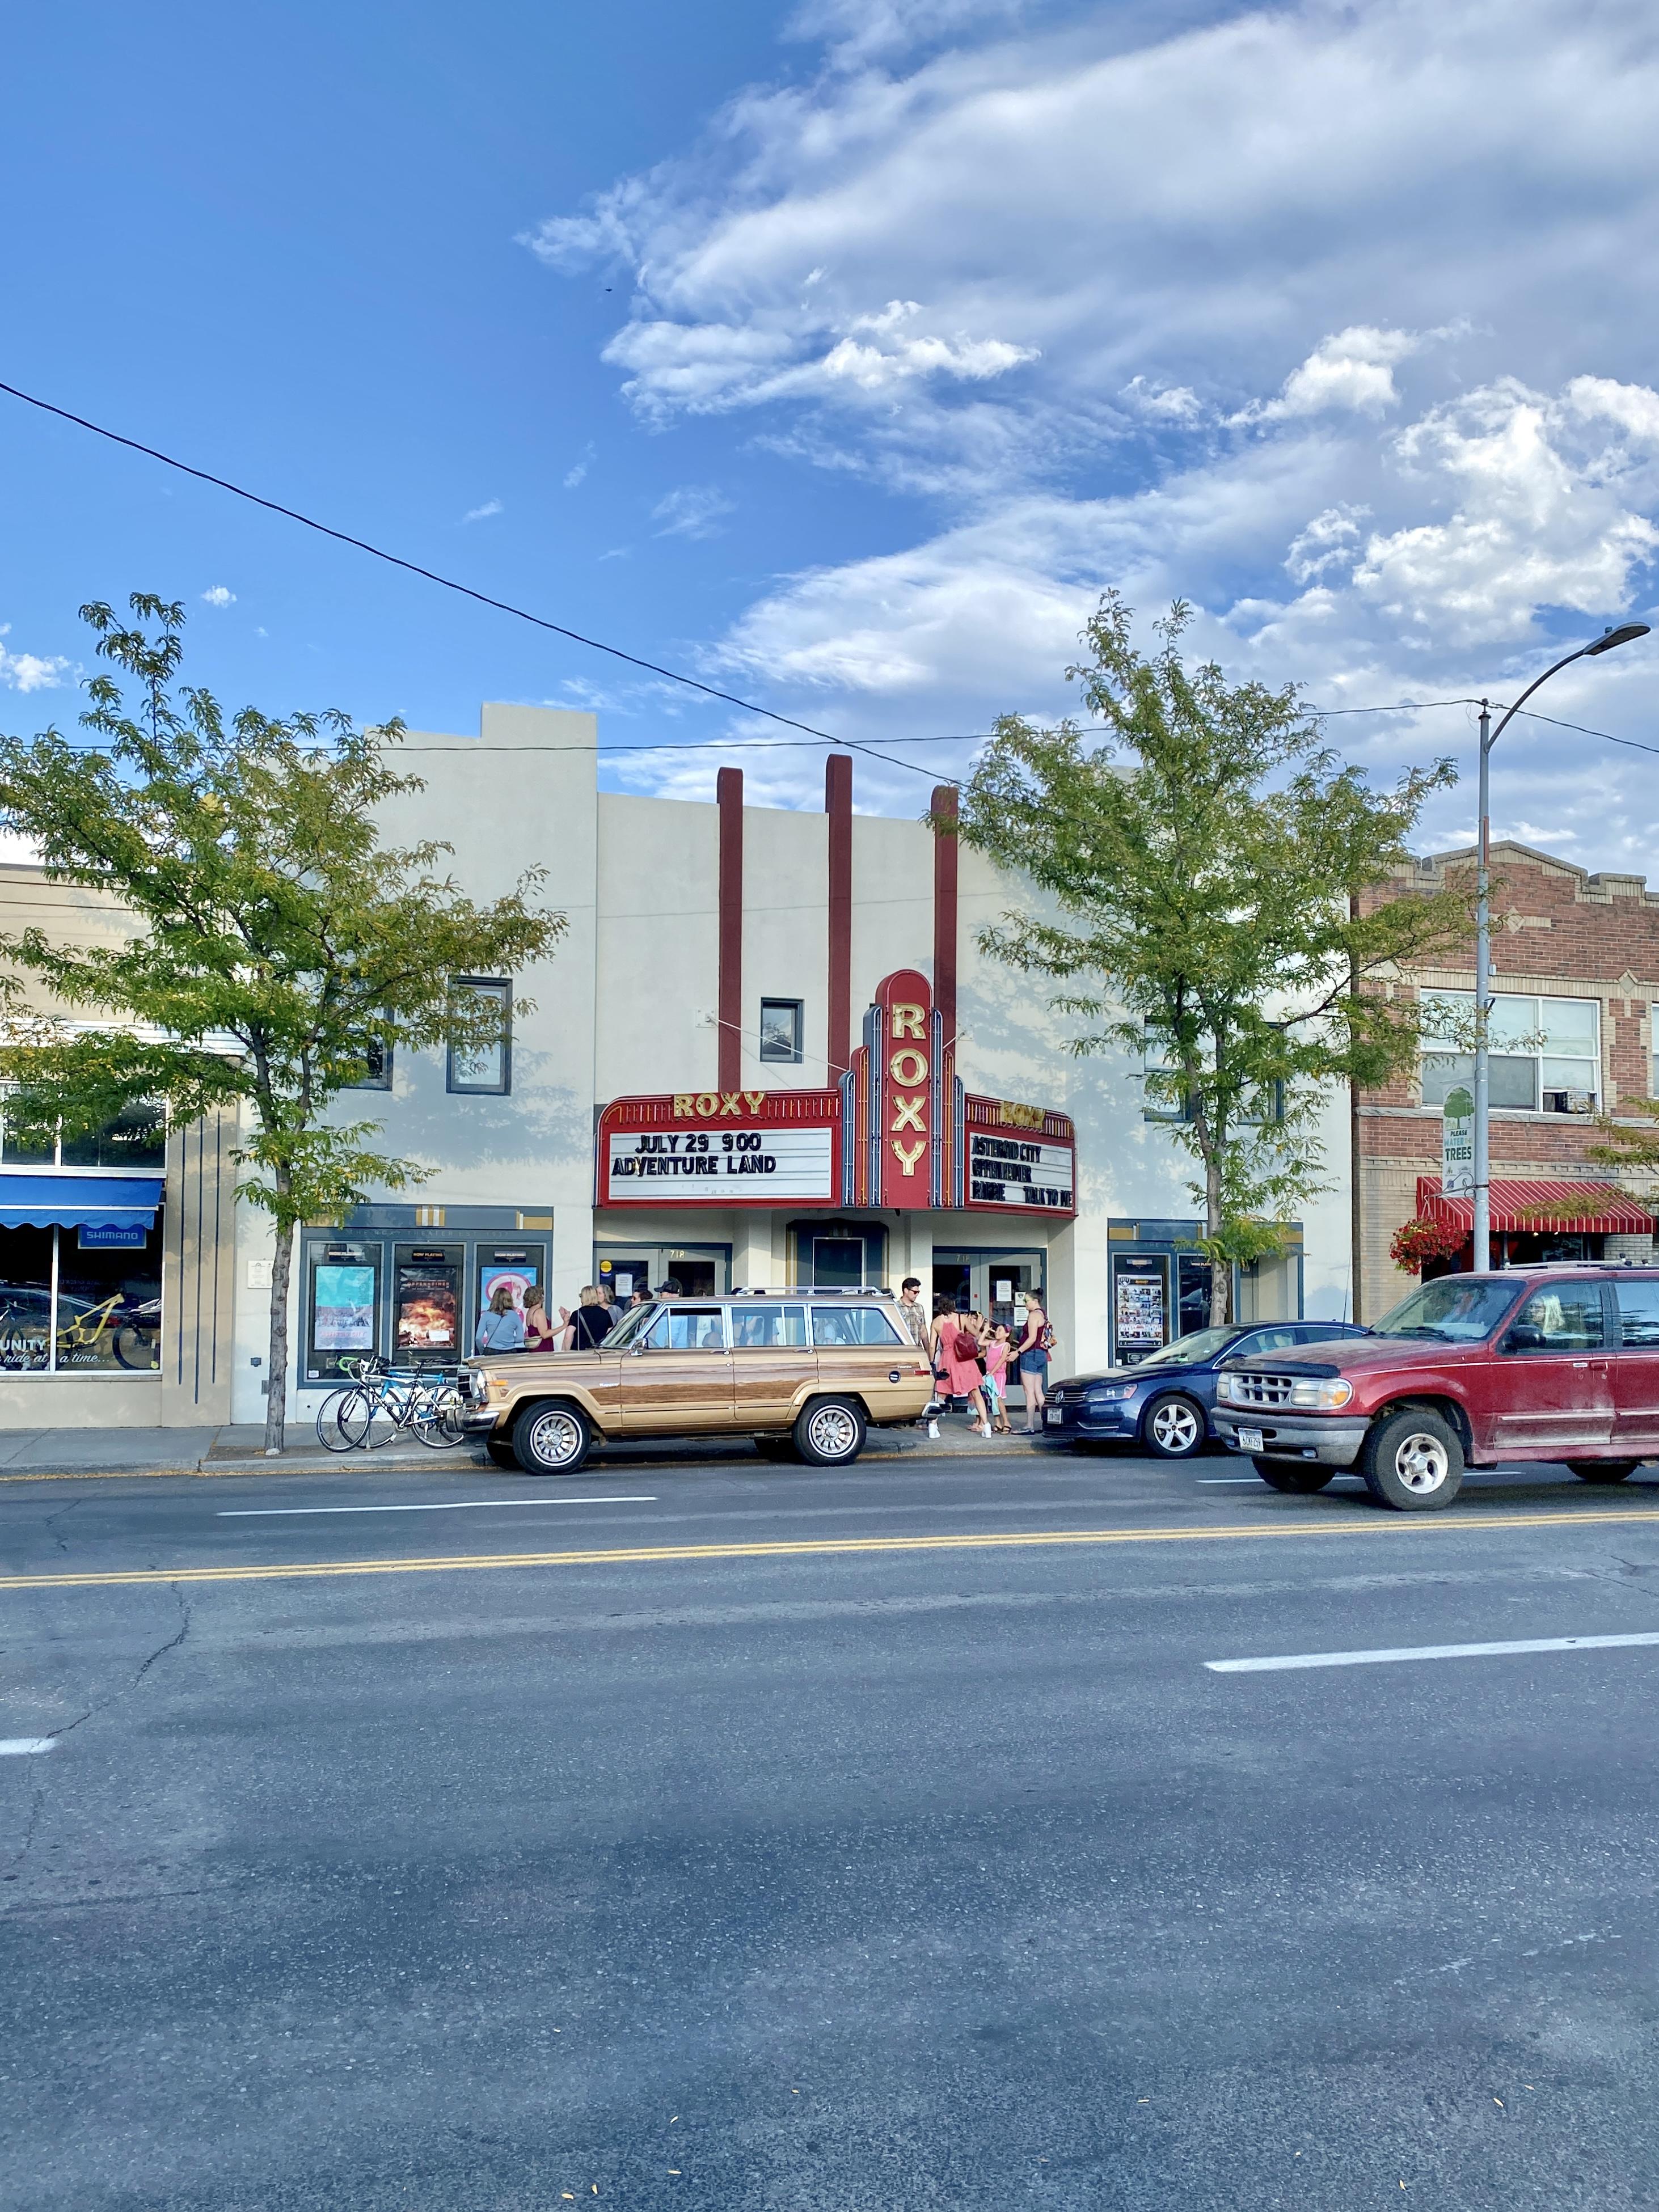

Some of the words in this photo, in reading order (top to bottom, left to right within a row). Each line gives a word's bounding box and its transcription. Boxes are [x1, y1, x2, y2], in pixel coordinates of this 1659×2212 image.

[890, 1003, 928, 1177] ROXY
[673, 1091, 767, 1118] ROXY
[1001, 1101, 1046, 1130] ROXY
[635, 1135, 679, 1153] JULY
[685, 1134, 709, 1153] 29
[1020, 1143, 1042, 1162] CITY
[1445, 1146, 1472, 1161] TREES
[611, 1156, 719, 1177] ADVENTURE
[727, 1155, 776, 1174] LAND
[1046, 1188, 1058, 1206] TO
[670, 1250, 685, 1259] 718
[3, 1352, 31, 1363] ride
[33, 1352, 48, 1363] at
